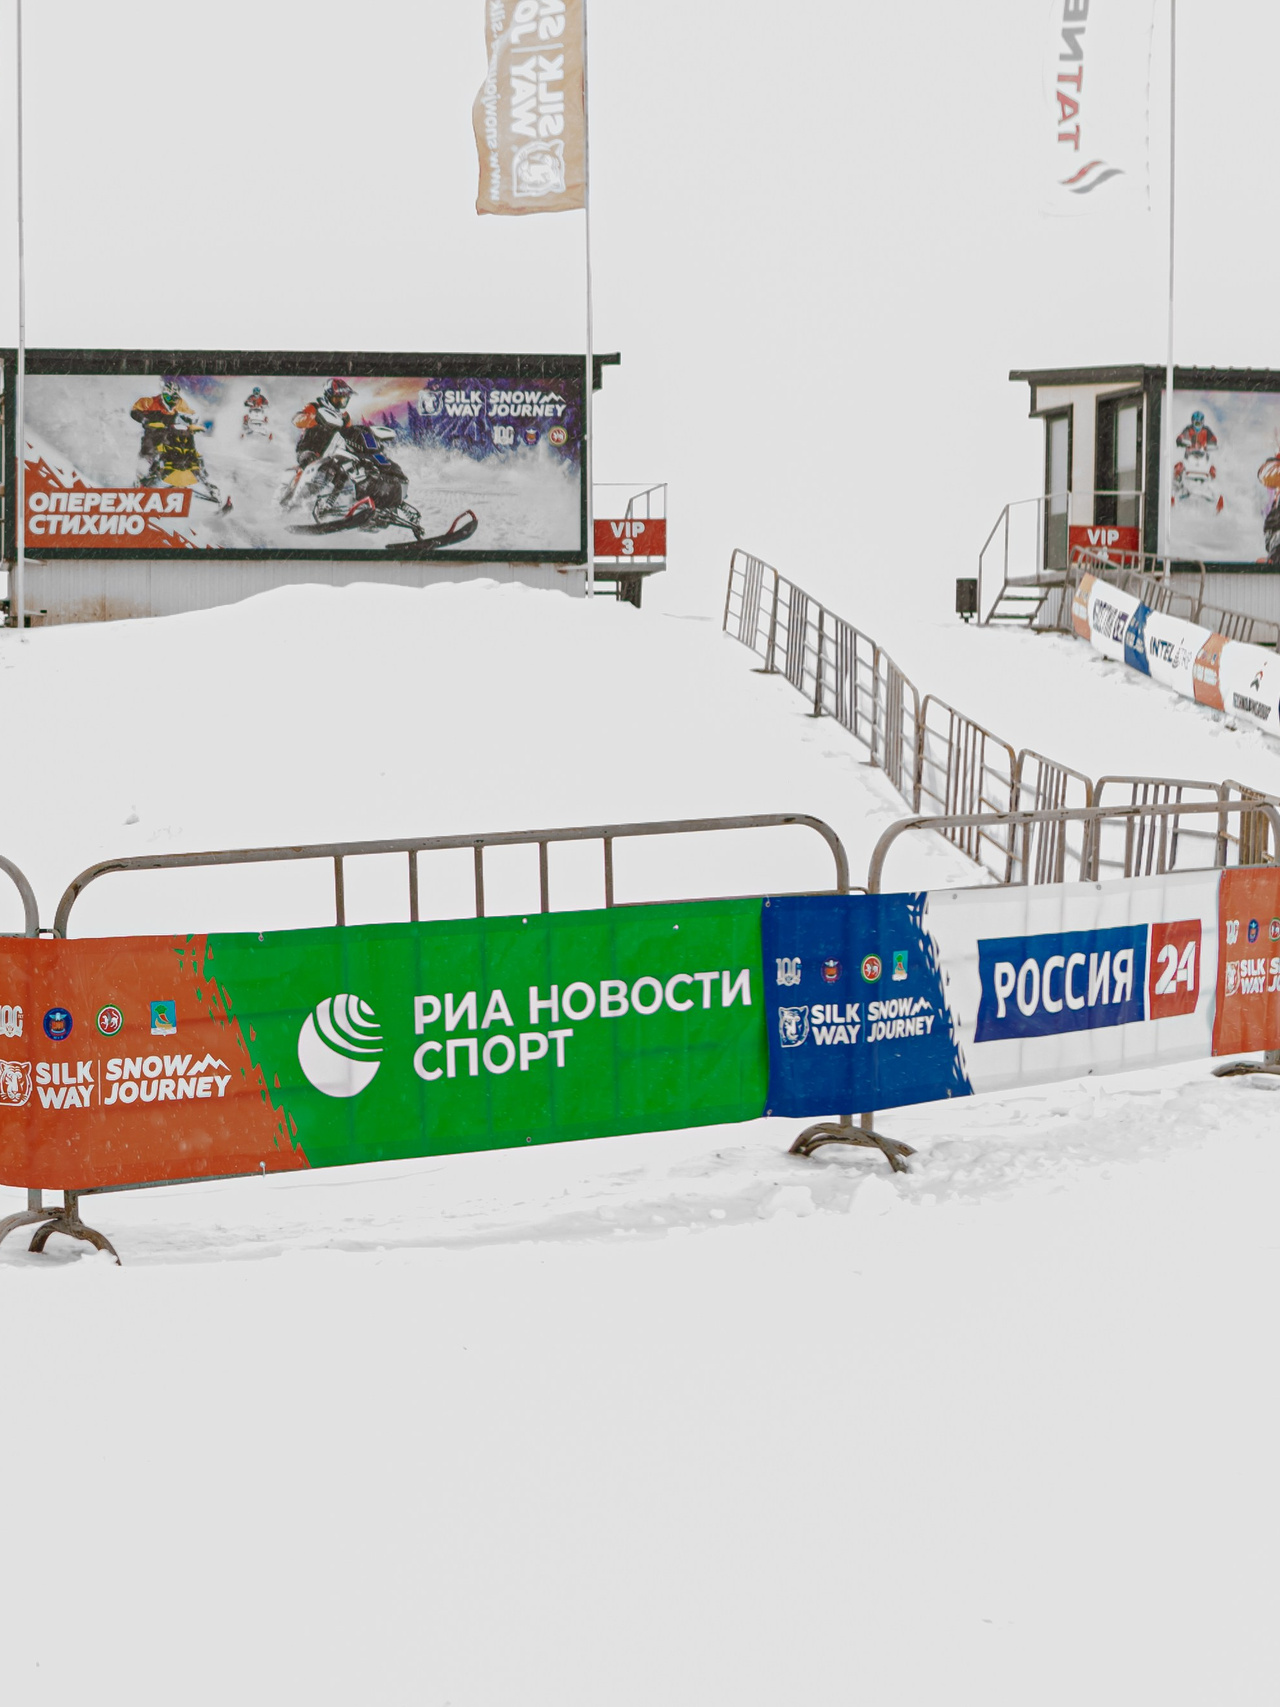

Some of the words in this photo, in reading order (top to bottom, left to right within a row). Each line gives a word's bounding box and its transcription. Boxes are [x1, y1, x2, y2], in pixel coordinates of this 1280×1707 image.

[444, 391, 482, 403] SILK
[489, 391, 541, 403] SNOW
[445, 404, 482, 417] WAY
[488, 404, 567, 417] JOURNEY
[28, 492, 184, 513] ОПЕРЕЖАЯ
[28, 514, 145, 535] СТИХИЮ
[610, 521, 645, 538] VIP
[621, 538, 634, 555] 3
[1087, 529, 1119, 546] VIP
[1241, 958, 1265, 977] SILK
[994, 948, 1134, 1019] РОССИЯ
[1155, 941, 1196, 995] 24
[1241, 976, 1265, 995] WAY
[414, 989, 514, 1035] РИА
[529, 968, 752, 1025] НОВОСТИ
[811, 1003, 861, 1024] SILK
[867, 997, 913, 1022] SNOW
[811, 1024, 861, 1046] WAY
[867, 1015, 935, 1043] JOURNEY
[413, 1028, 574, 1081] СПОРТ
[36, 1060, 94, 1085] SILK
[105, 1054, 192, 1080] SNOW
[37, 1084, 94, 1109] WAY
[104, 1075, 231, 1105] JOURNEY
